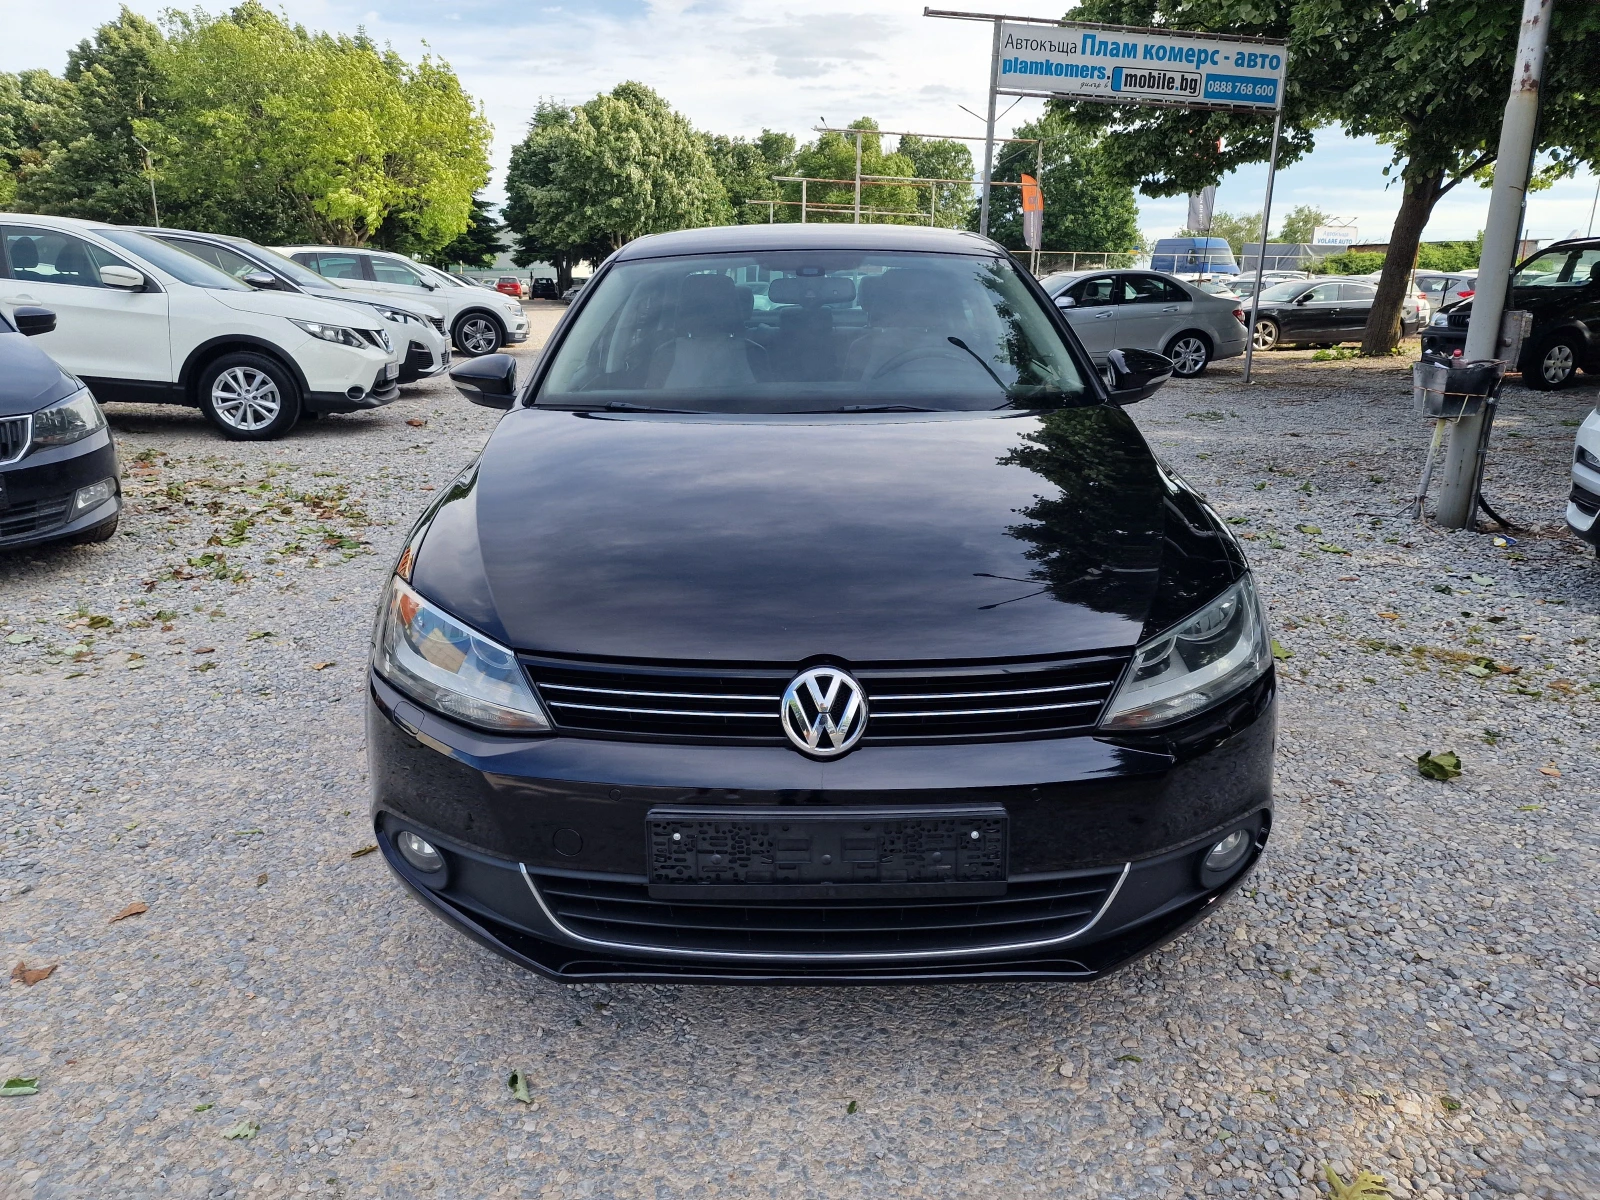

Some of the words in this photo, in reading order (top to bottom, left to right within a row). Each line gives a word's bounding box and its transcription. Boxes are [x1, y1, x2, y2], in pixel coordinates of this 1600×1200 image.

[1004, 33, 1077, 56] Автокъща
[1081, 33, 1137, 60] Плам
[1142, 44, 1220, 70] комерс
[1234, 51, 1281, 71] авто
[1123, 71, 1199, 95] mobile.bg
[1207, 80, 1232, 94] 0888
[1235, 82, 1254, 95] 768
[1255, 84, 1274, 97] 600
[1317, 237, 1338, 245] VOLARE
